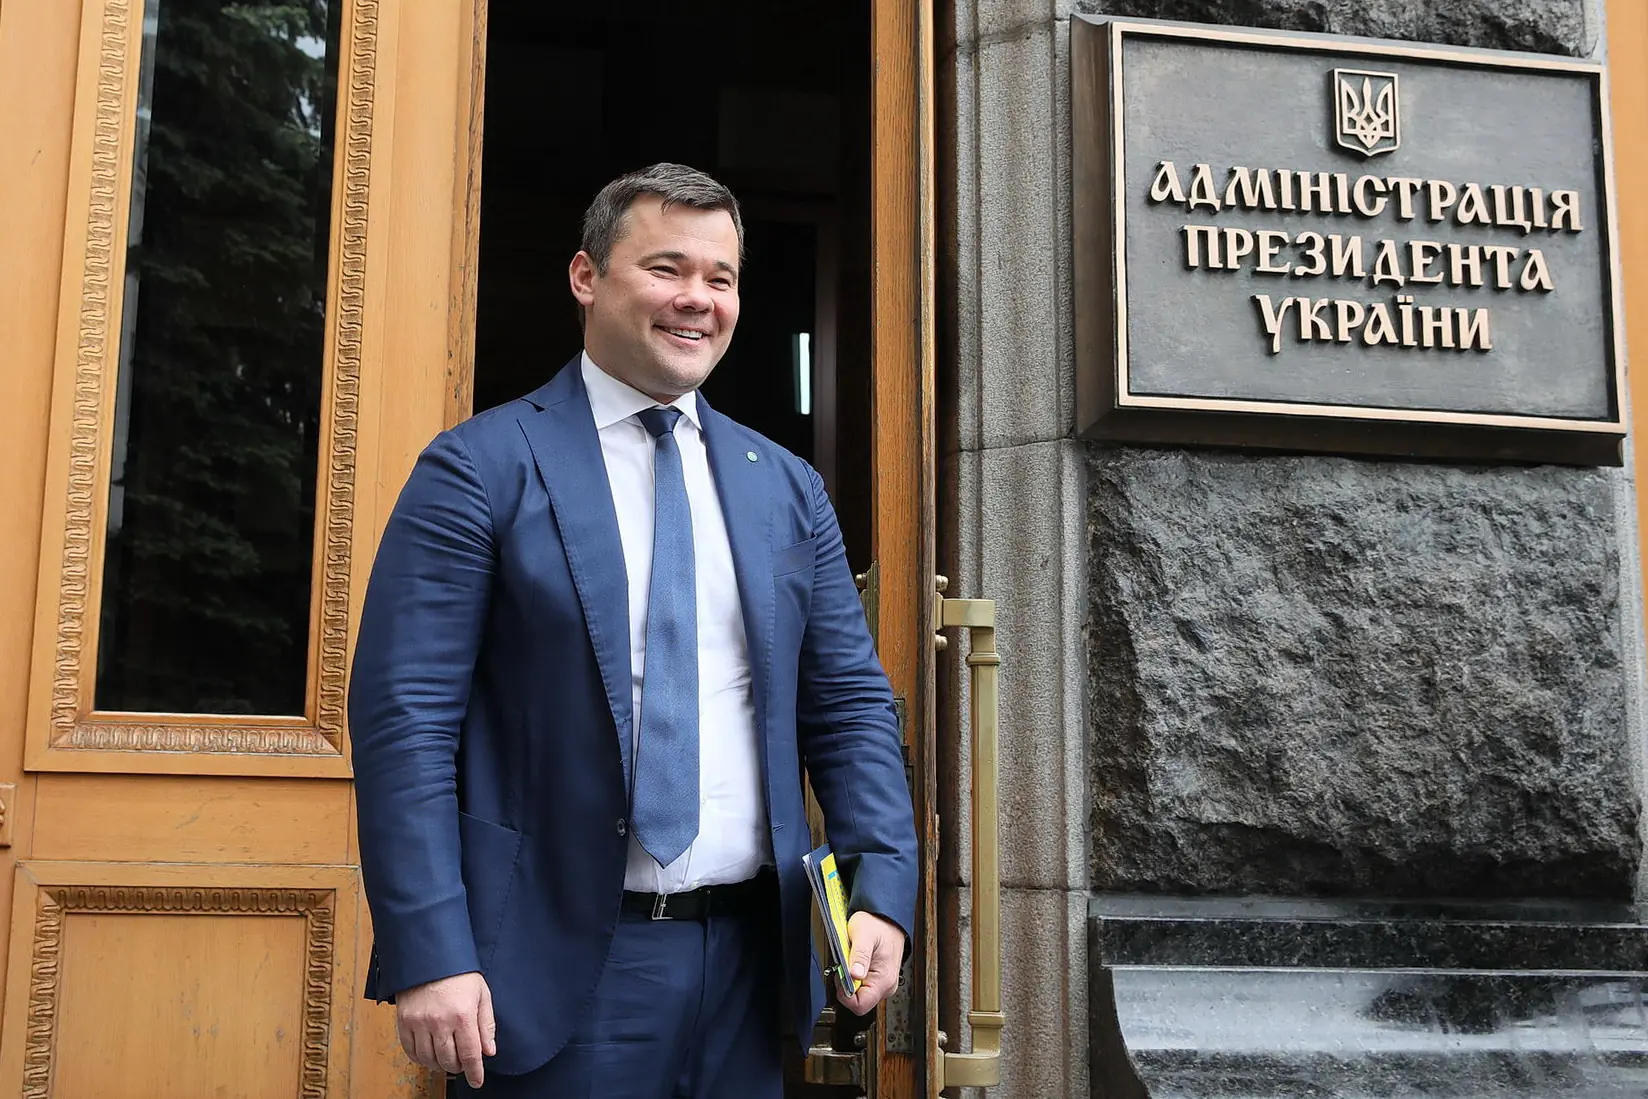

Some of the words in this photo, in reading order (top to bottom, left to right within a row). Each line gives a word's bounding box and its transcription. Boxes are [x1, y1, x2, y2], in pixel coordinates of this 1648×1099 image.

[1150, 161, 1583, 233] АДМІНІСТРАЦІЯ
[1182, 225, 1555, 291] ПРЕЗИДЕНТА
[1256, 294, 1493, 353] УКРАЇНИ
